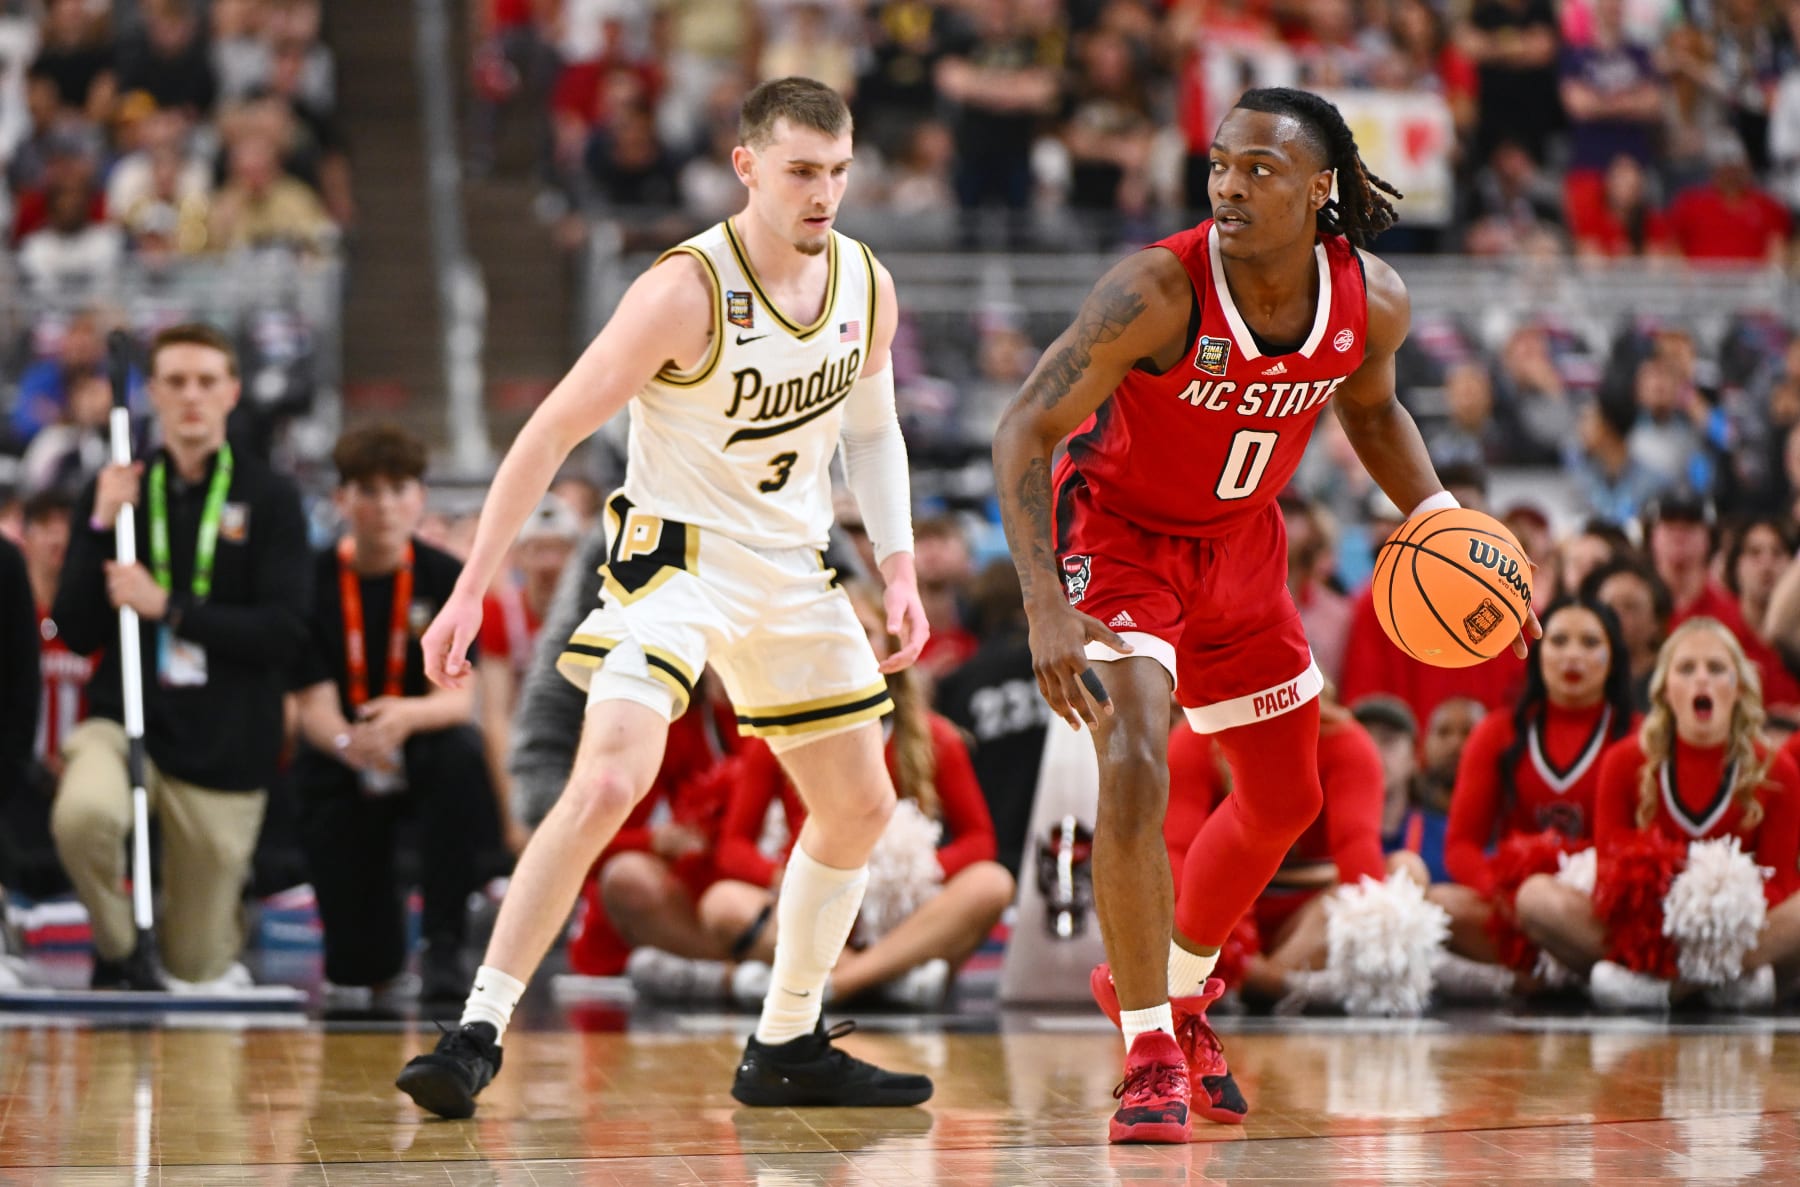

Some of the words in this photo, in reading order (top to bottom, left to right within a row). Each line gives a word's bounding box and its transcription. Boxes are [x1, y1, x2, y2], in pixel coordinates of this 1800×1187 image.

[1201, 353, 1222, 362] FOUR
[1203, 345, 1223, 354] FINAL
[724, 347, 860, 422] Purdue
[1177, 379, 1237, 412] NC
[1235, 375, 1348, 418] STATE
[757, 450, 799, 494] 3
[1214, 428, 1281, 501] 0
[616, 507, 664, 562] P
[1468, 537, 1532, 613] Wilson
[1108, 619, 1138, 628] adidas
[1253, 680, 1301, 718] PACK
